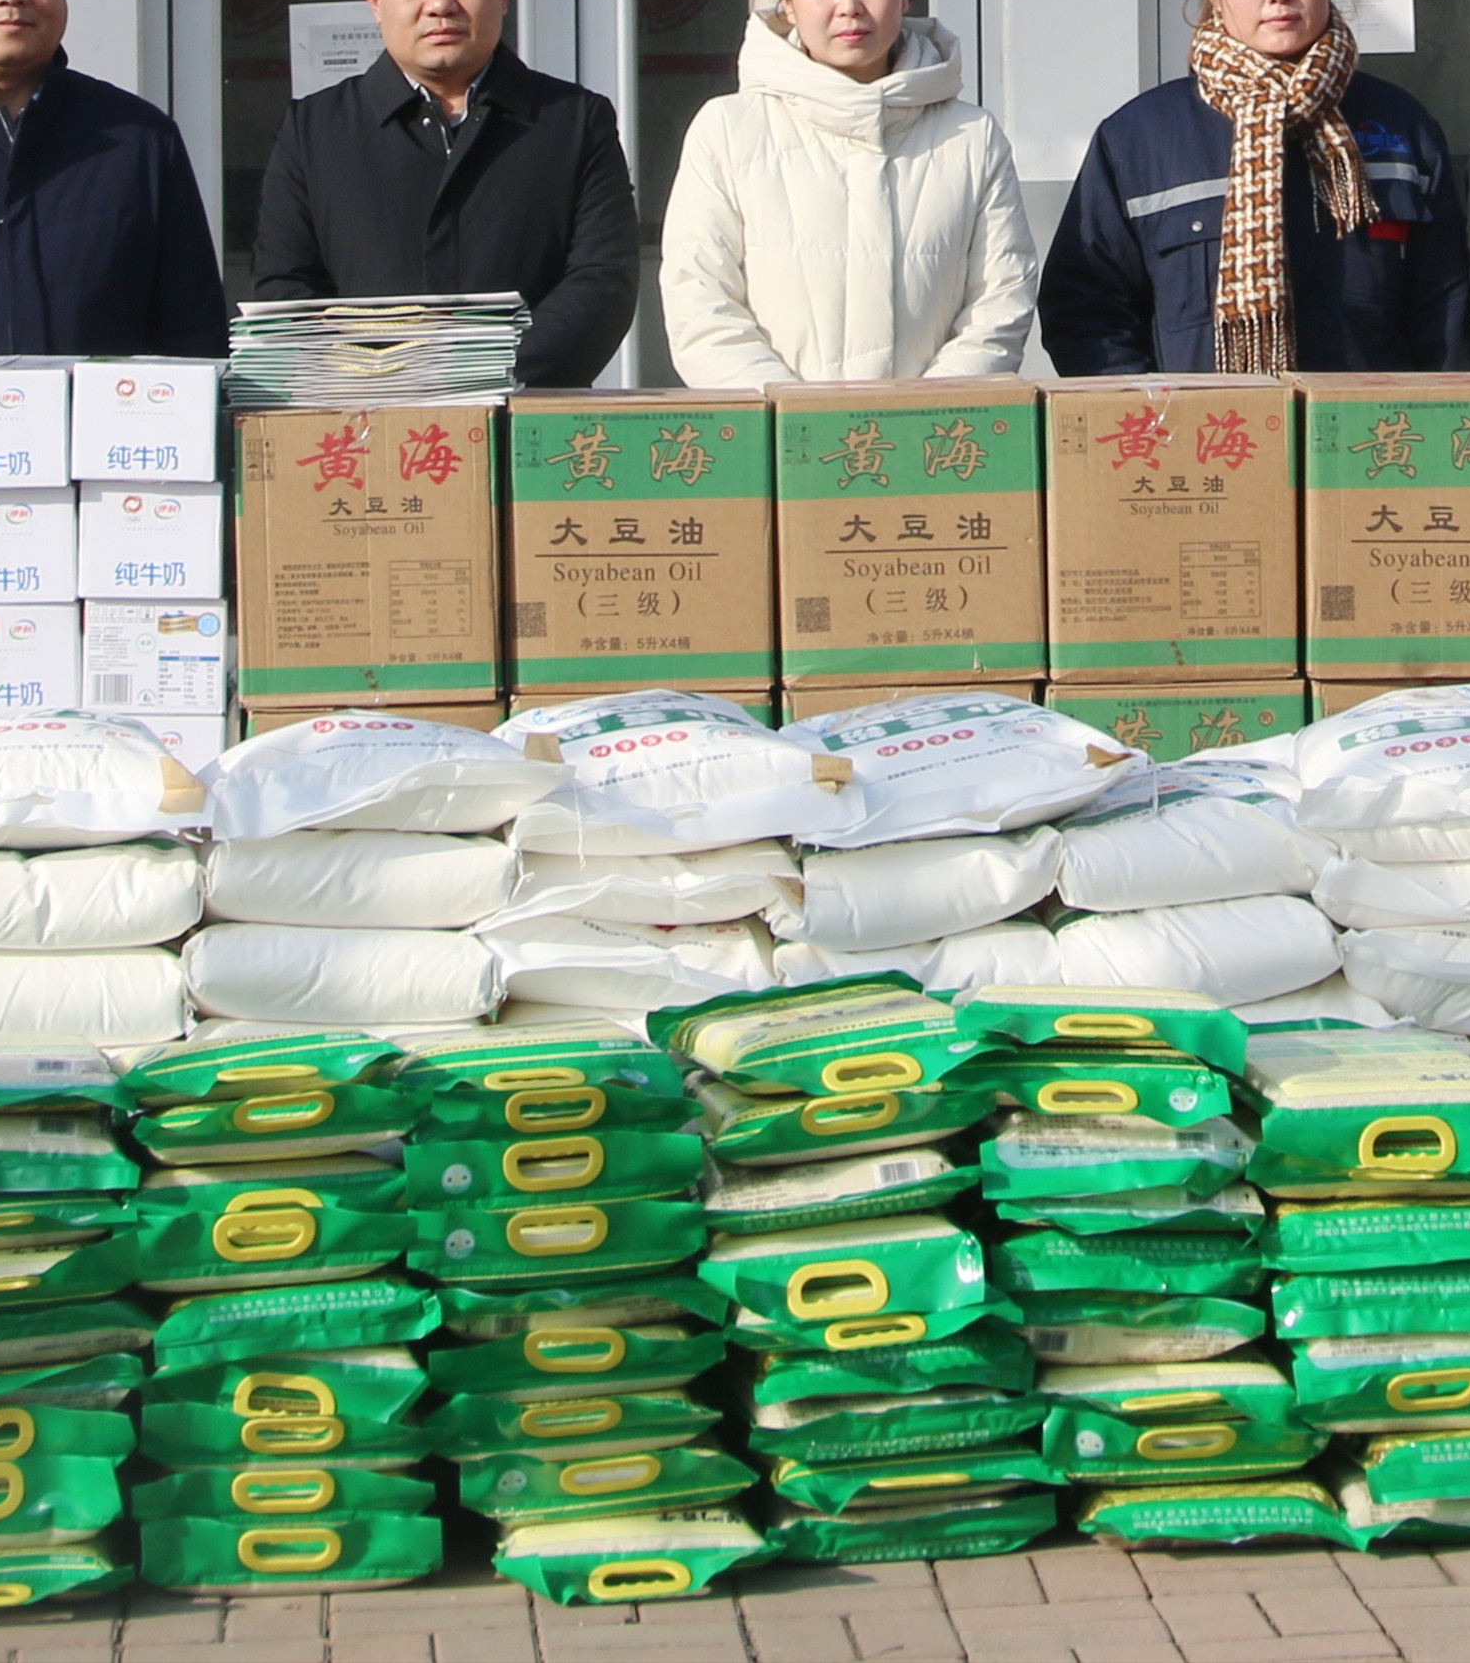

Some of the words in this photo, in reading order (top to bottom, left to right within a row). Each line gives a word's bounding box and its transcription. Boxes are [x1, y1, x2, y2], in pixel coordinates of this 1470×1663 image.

[1095, 405, 1259, 471] 黄海
[107, 446, 178, 469] 纯牛奶
[296, 423, 463, 492] 黄海
[546, 422, 717, 491] 黄海
[818, 417, 989, 490] 黄海
[1131, 474, 1225, 495] 大豆油
[329, 495, 423, 516] 大豆油
[1130, 501, 1193, 517] Soyabean
[1199, 500, 1221, 514] Oil
[333, 522, 397, 539] Soyabean
[403, 520, 425, 536] Oil
[549, 516, 704, 547] 大豆油
[839, 513, 993, 543] 大豆油
[115, 562, 185, 586] 纯牛奶
[552, 562, 656, 587] Soyabean
[669, 560, 702, 582] Oil
[843, 556, 946, 584] Soyabean
[958, 555, 992, 576] Oil
[1369, 548, 1470, 573] Soyabean
